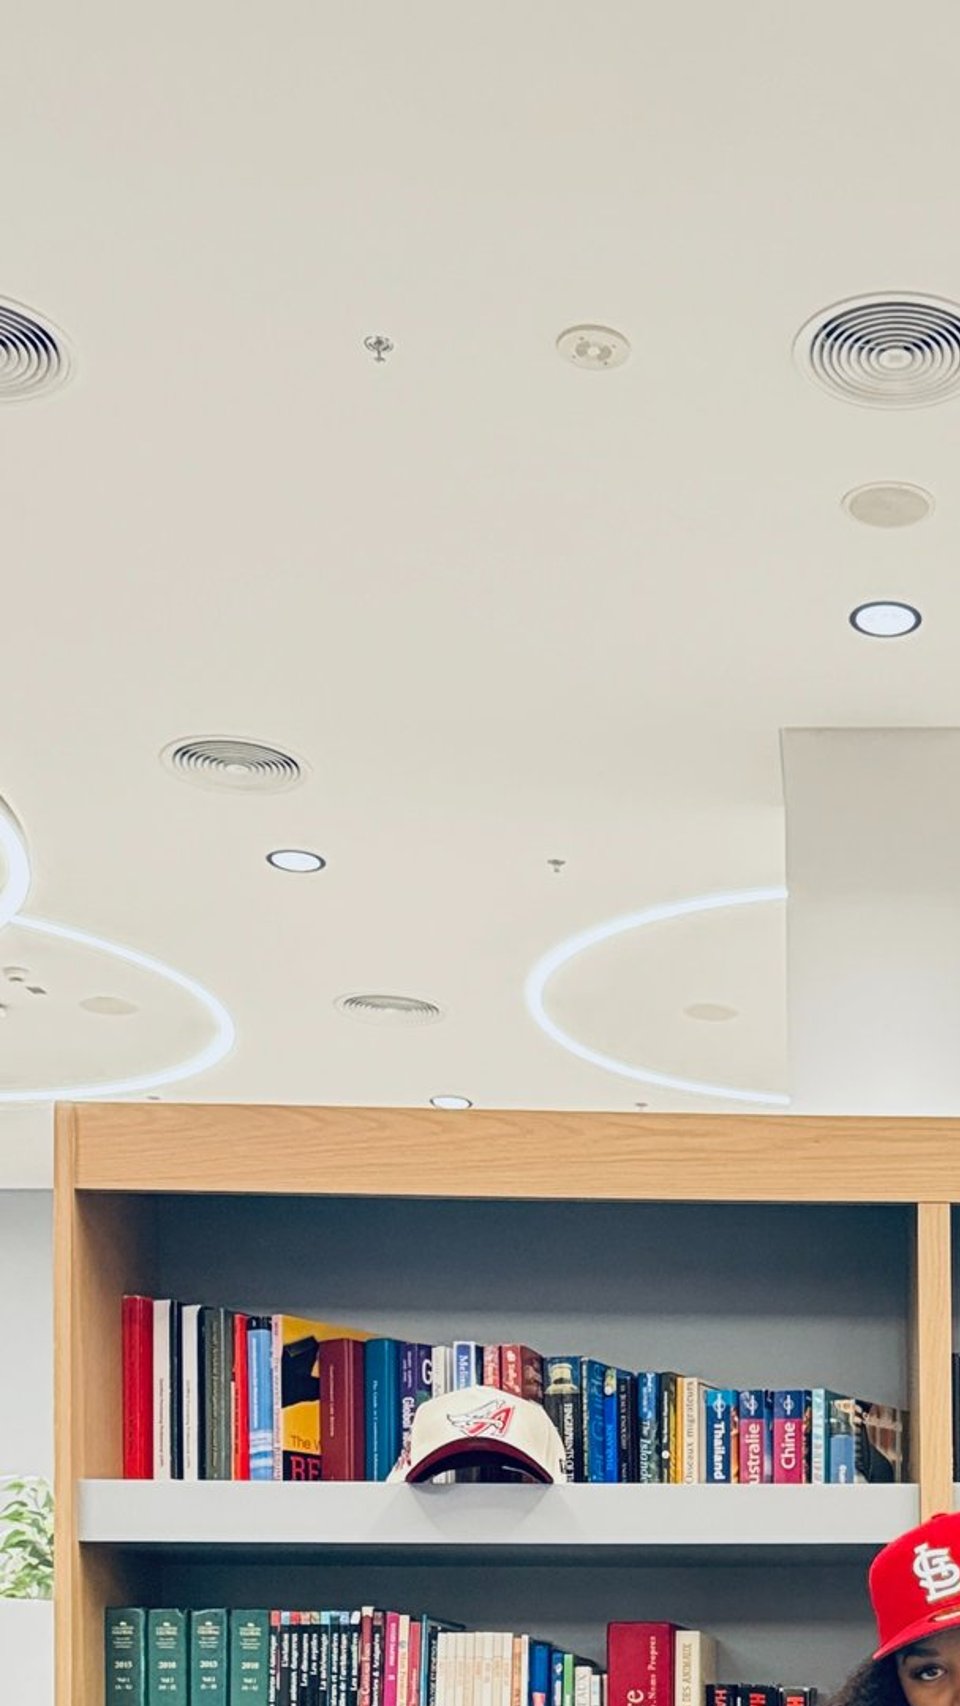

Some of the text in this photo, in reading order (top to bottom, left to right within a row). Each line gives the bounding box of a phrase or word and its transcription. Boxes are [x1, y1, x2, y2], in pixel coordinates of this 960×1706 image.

[640, 1438, 653, 1483] Islande
[713, 1421, 725, 1480] Thailand
[748, 1423, 760, 1484] ustralie
[780, 1422, 796, 1470] Chine
[648, 1636, 658, 1670] Propres
[682, 1686, 691, 1702] DES
